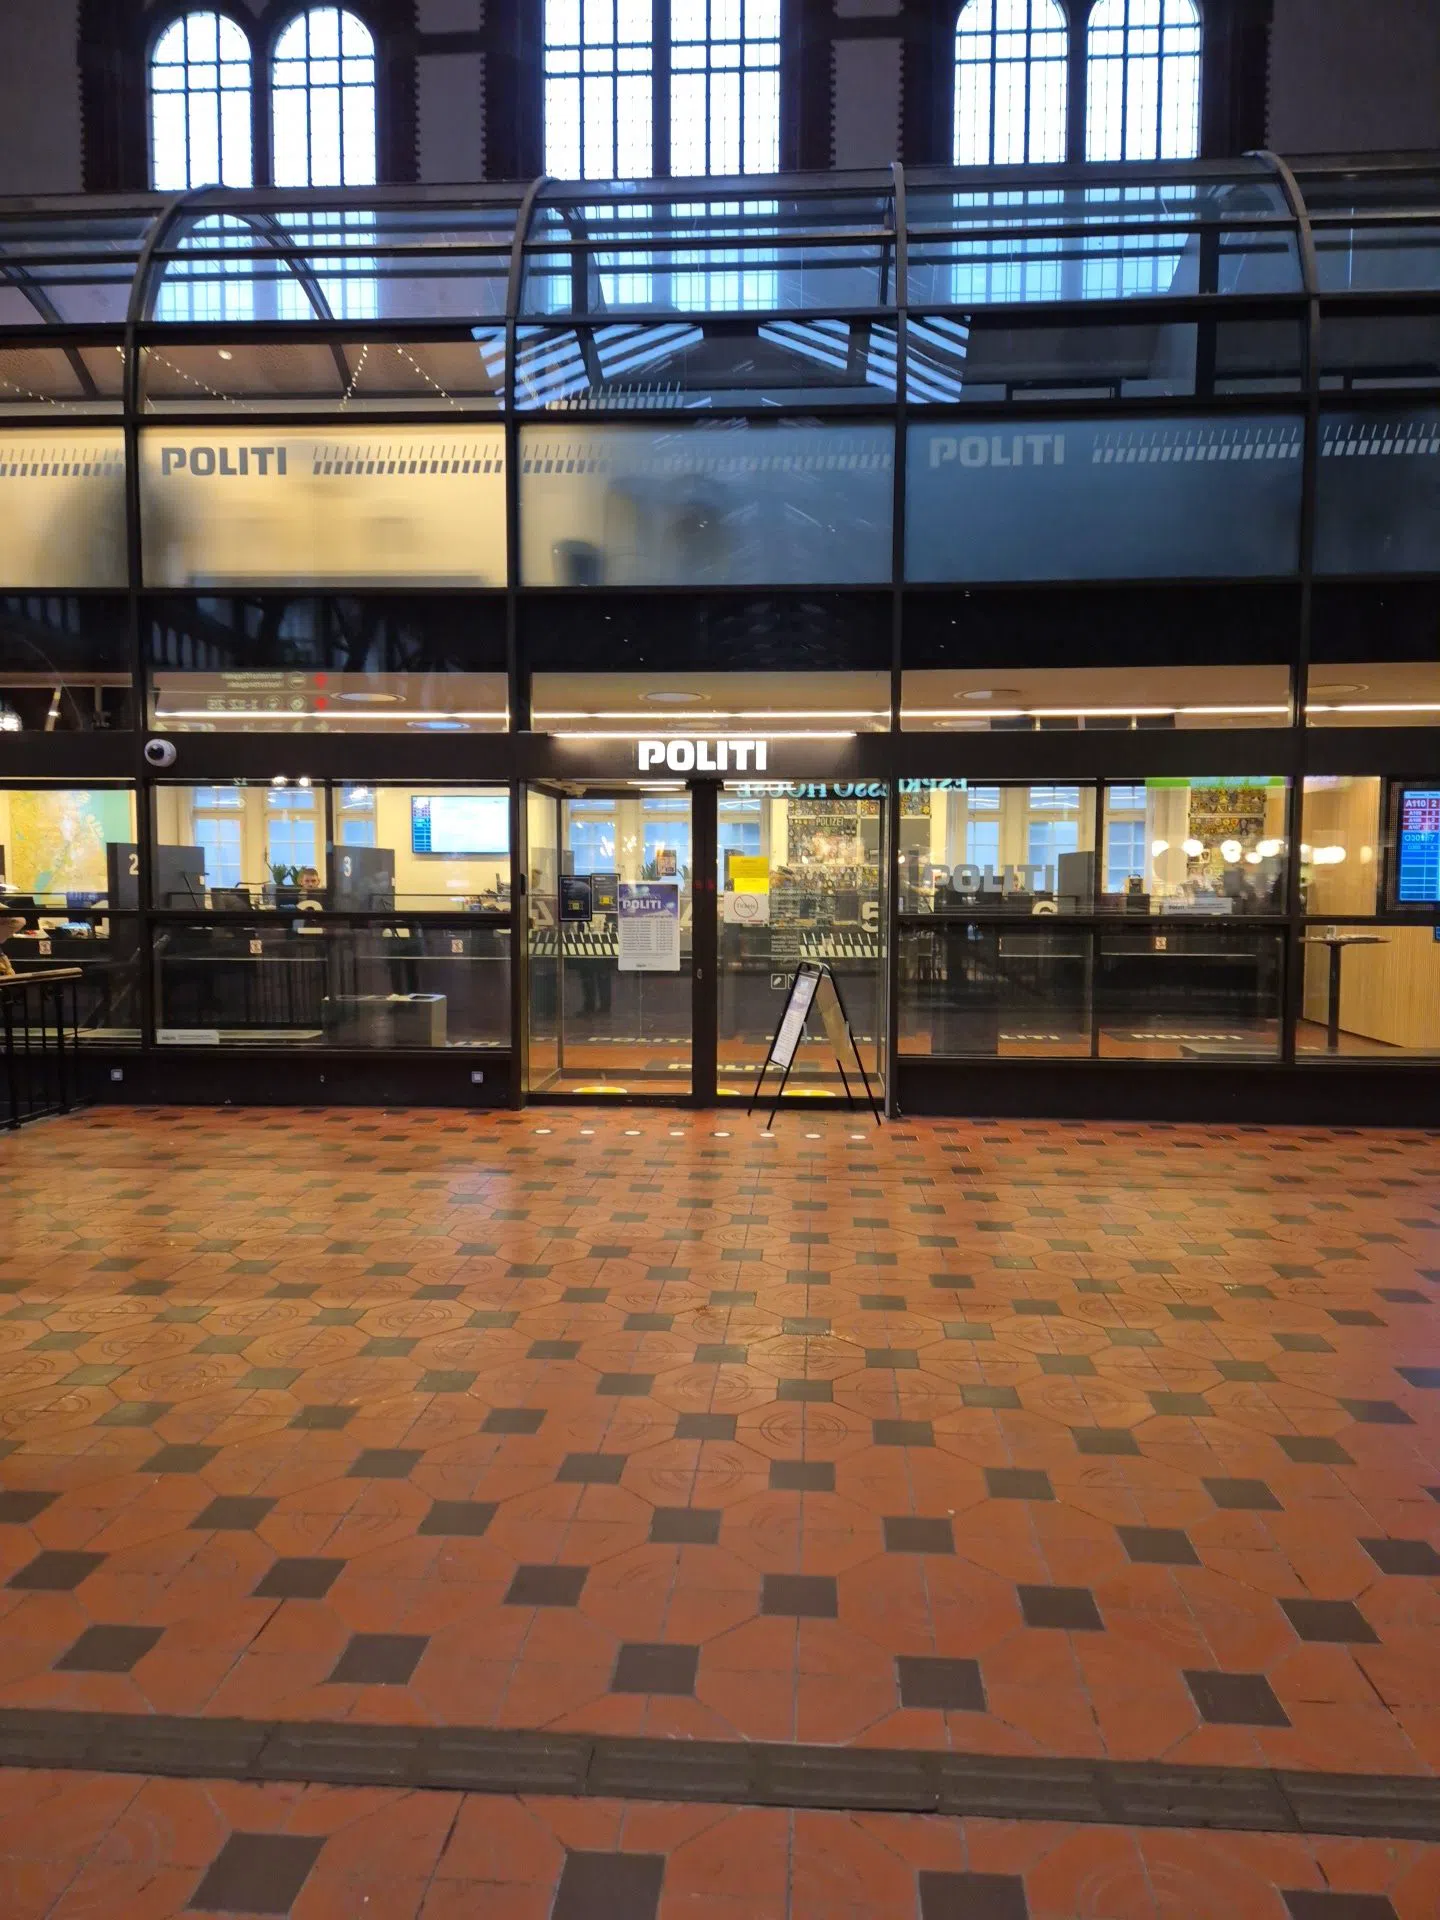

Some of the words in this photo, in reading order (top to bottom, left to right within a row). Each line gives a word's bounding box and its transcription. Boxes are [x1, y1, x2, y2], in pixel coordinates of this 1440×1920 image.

[162, 447, 287, 476] POLITI
[929, 434, 1065, 468] POLITI
[638, 740, 767, 771] POLITI
[1406, 799, 1426, 808] A110
[1431, 800, 1437, 808] 2
[815, 817, 844, 827] POLIZEI
[128, 853, 139, 876] 2
[343, 855, 352, 877] 3
[922, 864, 1055, 894] POLITI
[622, 899, 662, 910] POLITI
[861, 901, 879, 933] 5
[1131, 1033, 1243, 1041] POLITI
